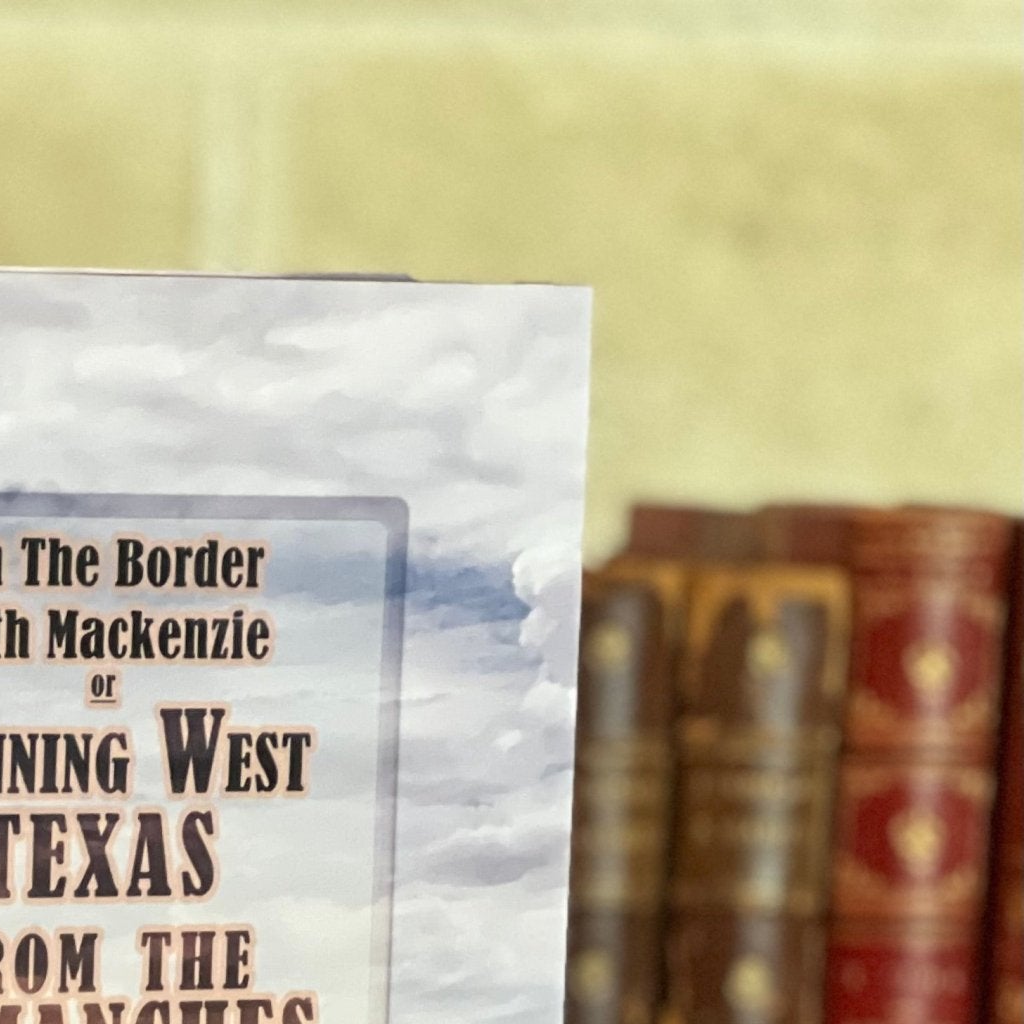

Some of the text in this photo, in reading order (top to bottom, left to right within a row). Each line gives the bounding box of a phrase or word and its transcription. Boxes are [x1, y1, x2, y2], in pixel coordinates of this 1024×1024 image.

[21, 538, 100, 587] The
[115, 538, 264, 588] Border
[47, 610, 270, 660] Mackenzie
[90, 673, 117, 699] or
[160, 708, 311, 794] WEST
[140, 930, 251, 991] THE
